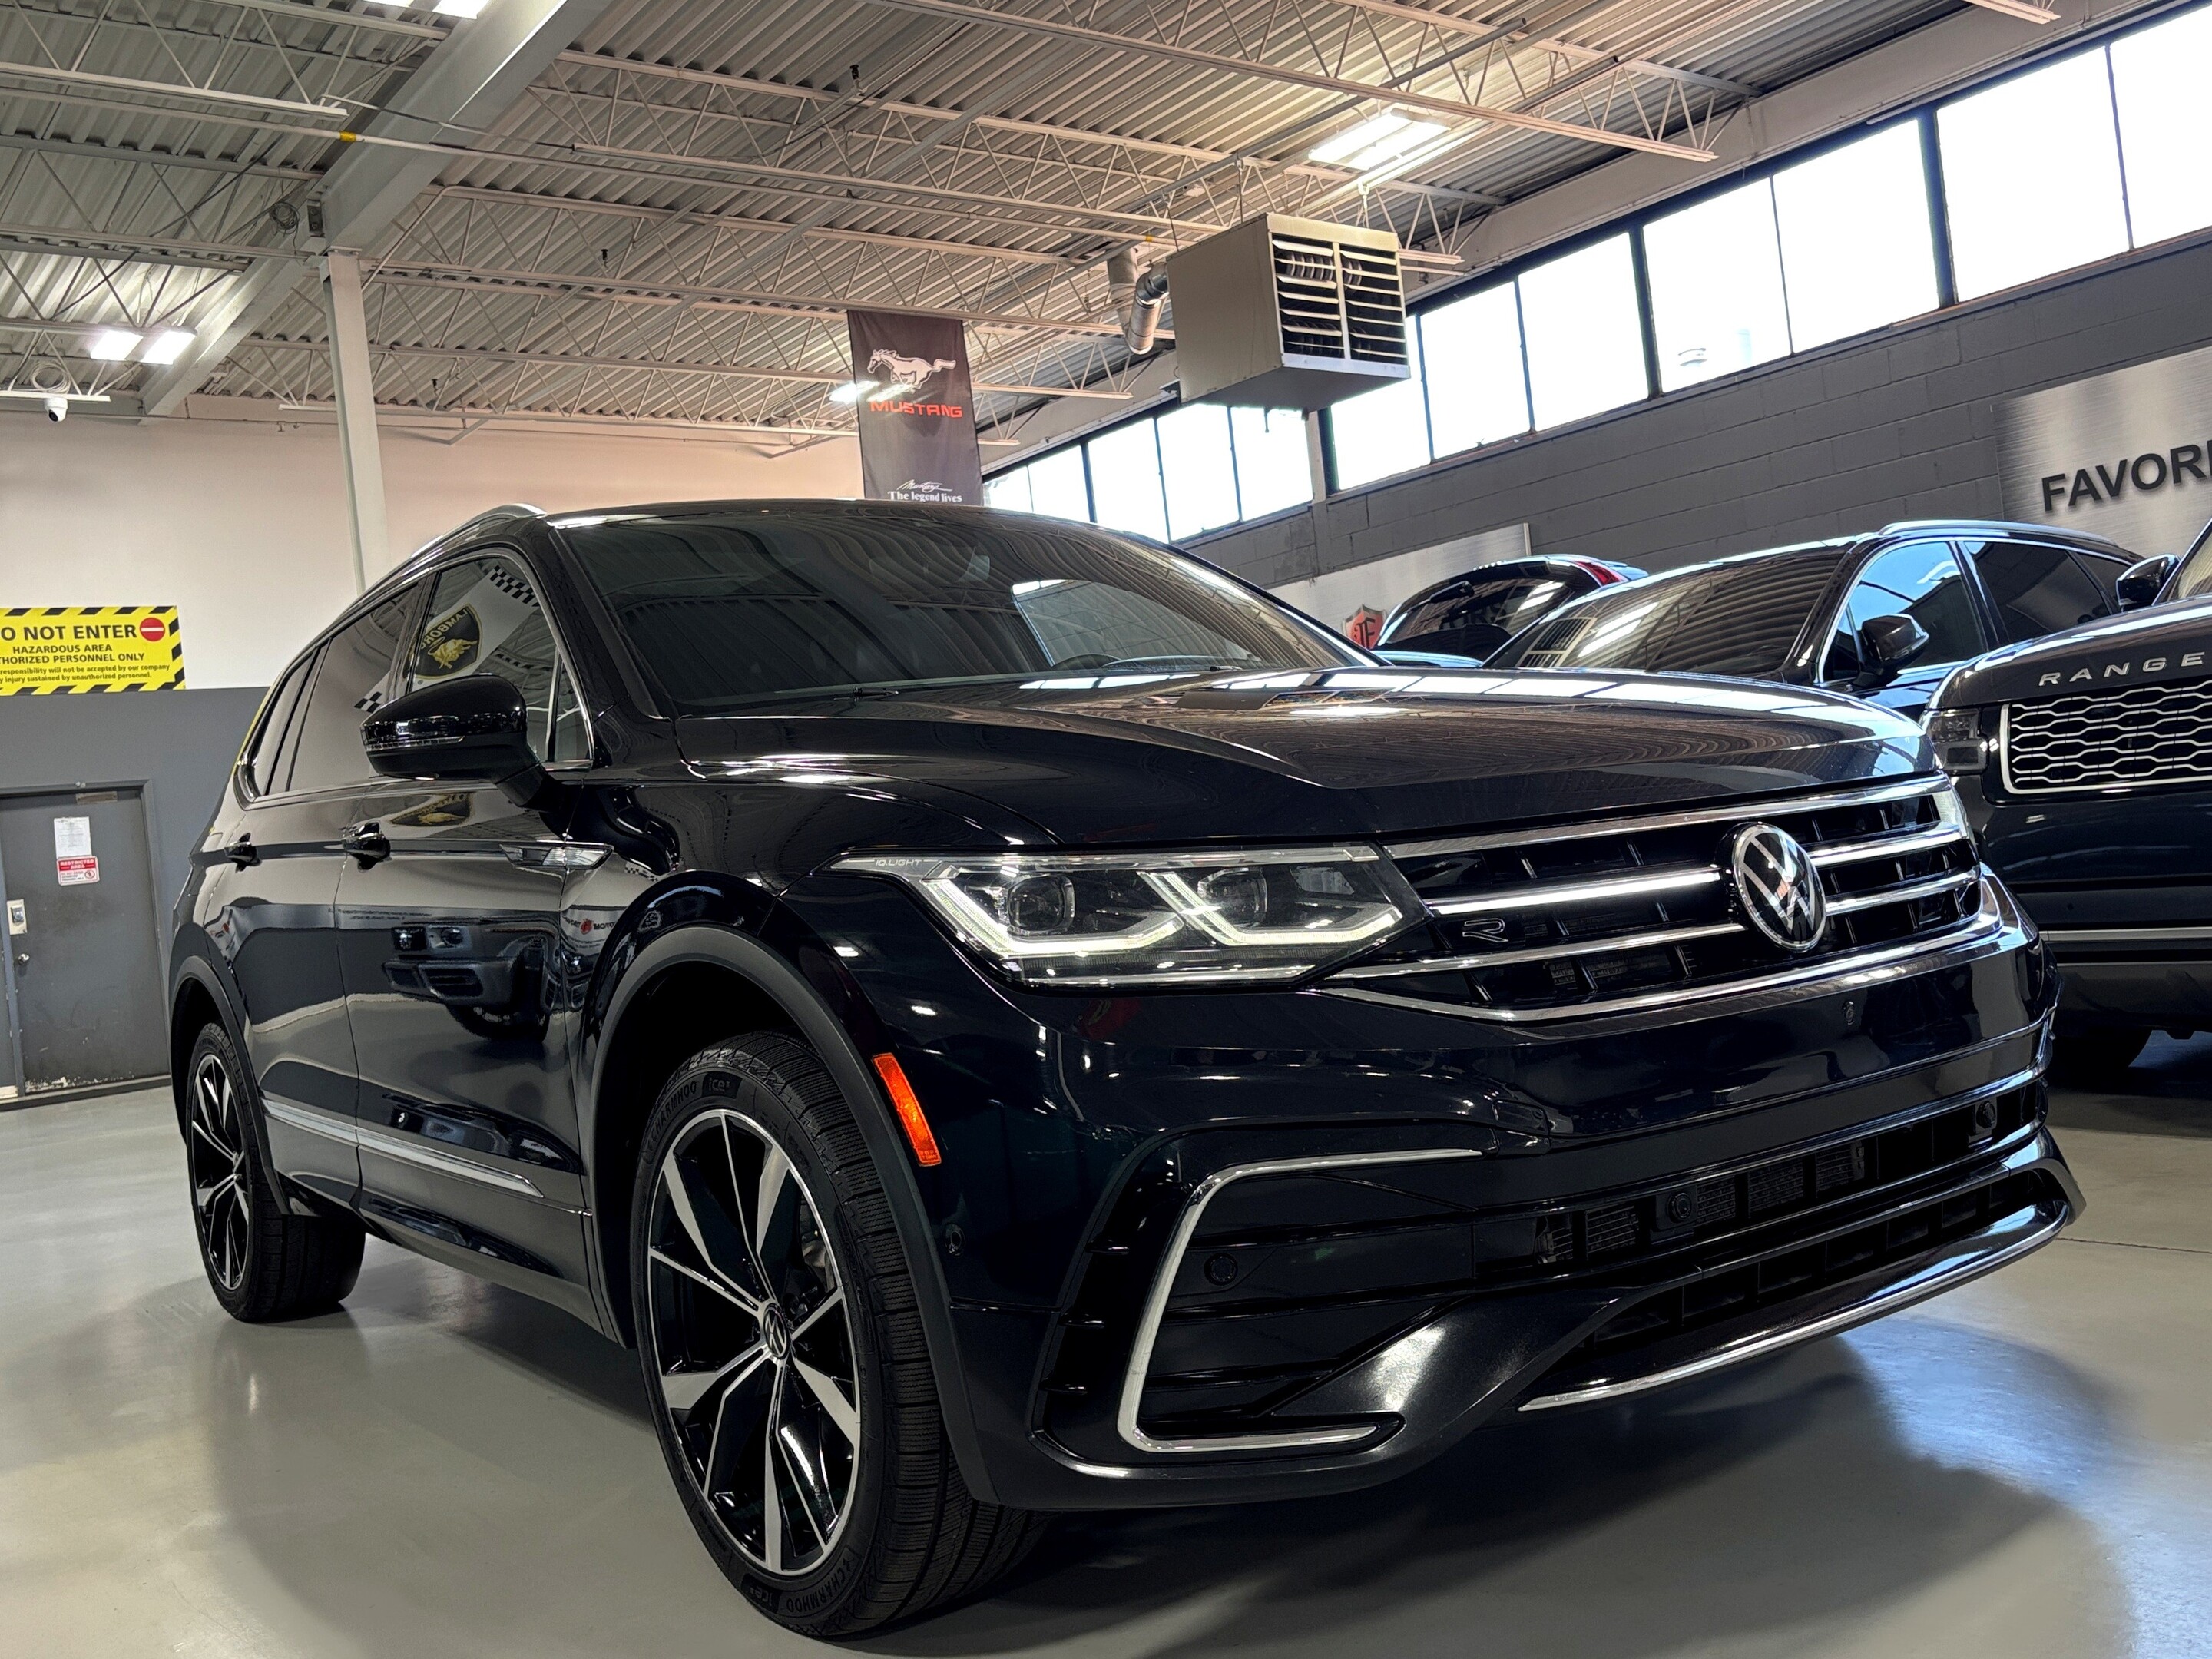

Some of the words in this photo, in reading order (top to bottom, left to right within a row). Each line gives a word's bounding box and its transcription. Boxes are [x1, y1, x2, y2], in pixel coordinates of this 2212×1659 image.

[870, 400, 963, 418] MUSTANG
[887, 491, 909, 500] The
[911, 491, 940, 502] legend
[941, 492, 962, 502] lives
[24, 625, 67, 641] NOT
[73, 624, 137, 639] ENTER
[12, 644, 81, 654] HAZARDOUS
[84, 644, 113, 652] AREA
[0, 655, 50, 664] HORIZED
[53, 654, 115, 663] PERSONNEL
[118, 653, 144, 661] ONLY
[2038, 651, 2205, 687] RANGE
[876, 859, 922, 867] IQ.LIGHT
